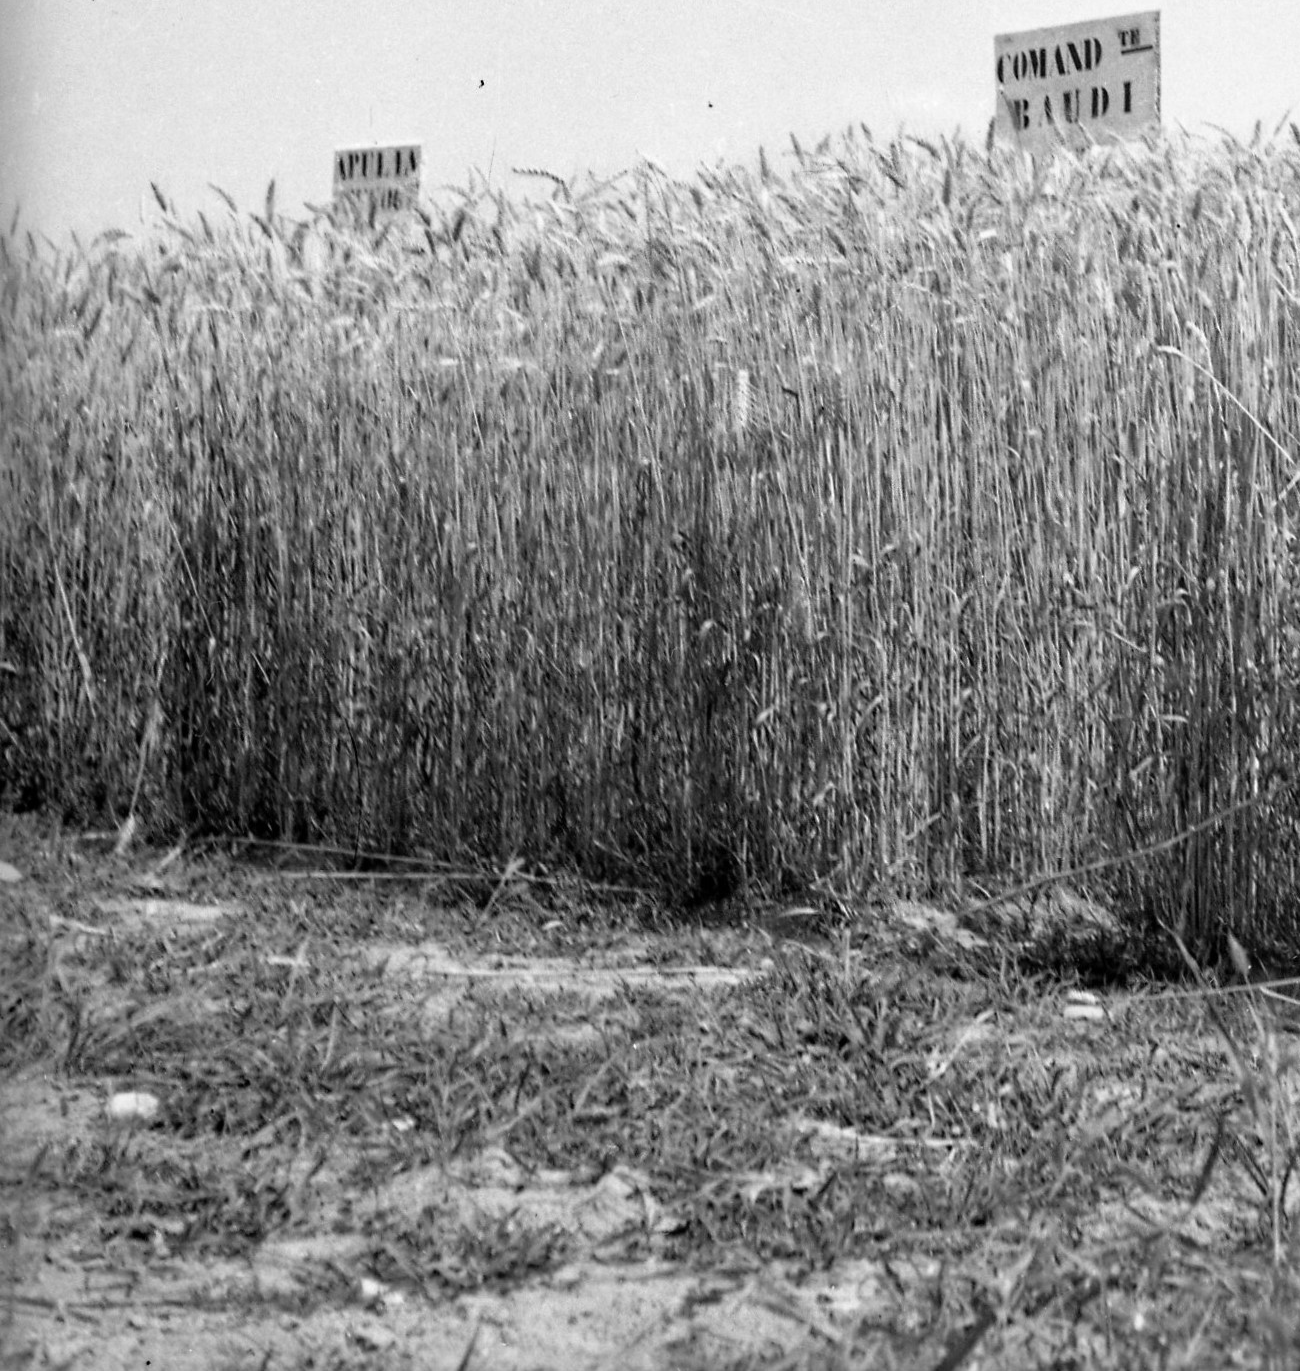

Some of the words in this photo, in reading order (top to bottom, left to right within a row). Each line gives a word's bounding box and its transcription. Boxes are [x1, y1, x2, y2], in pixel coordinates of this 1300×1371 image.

[997, 37, 1103, 84] COMAND
[1010, 81, 1132, 130] BAUDI
[339, 149, 417, 181] APULIA
